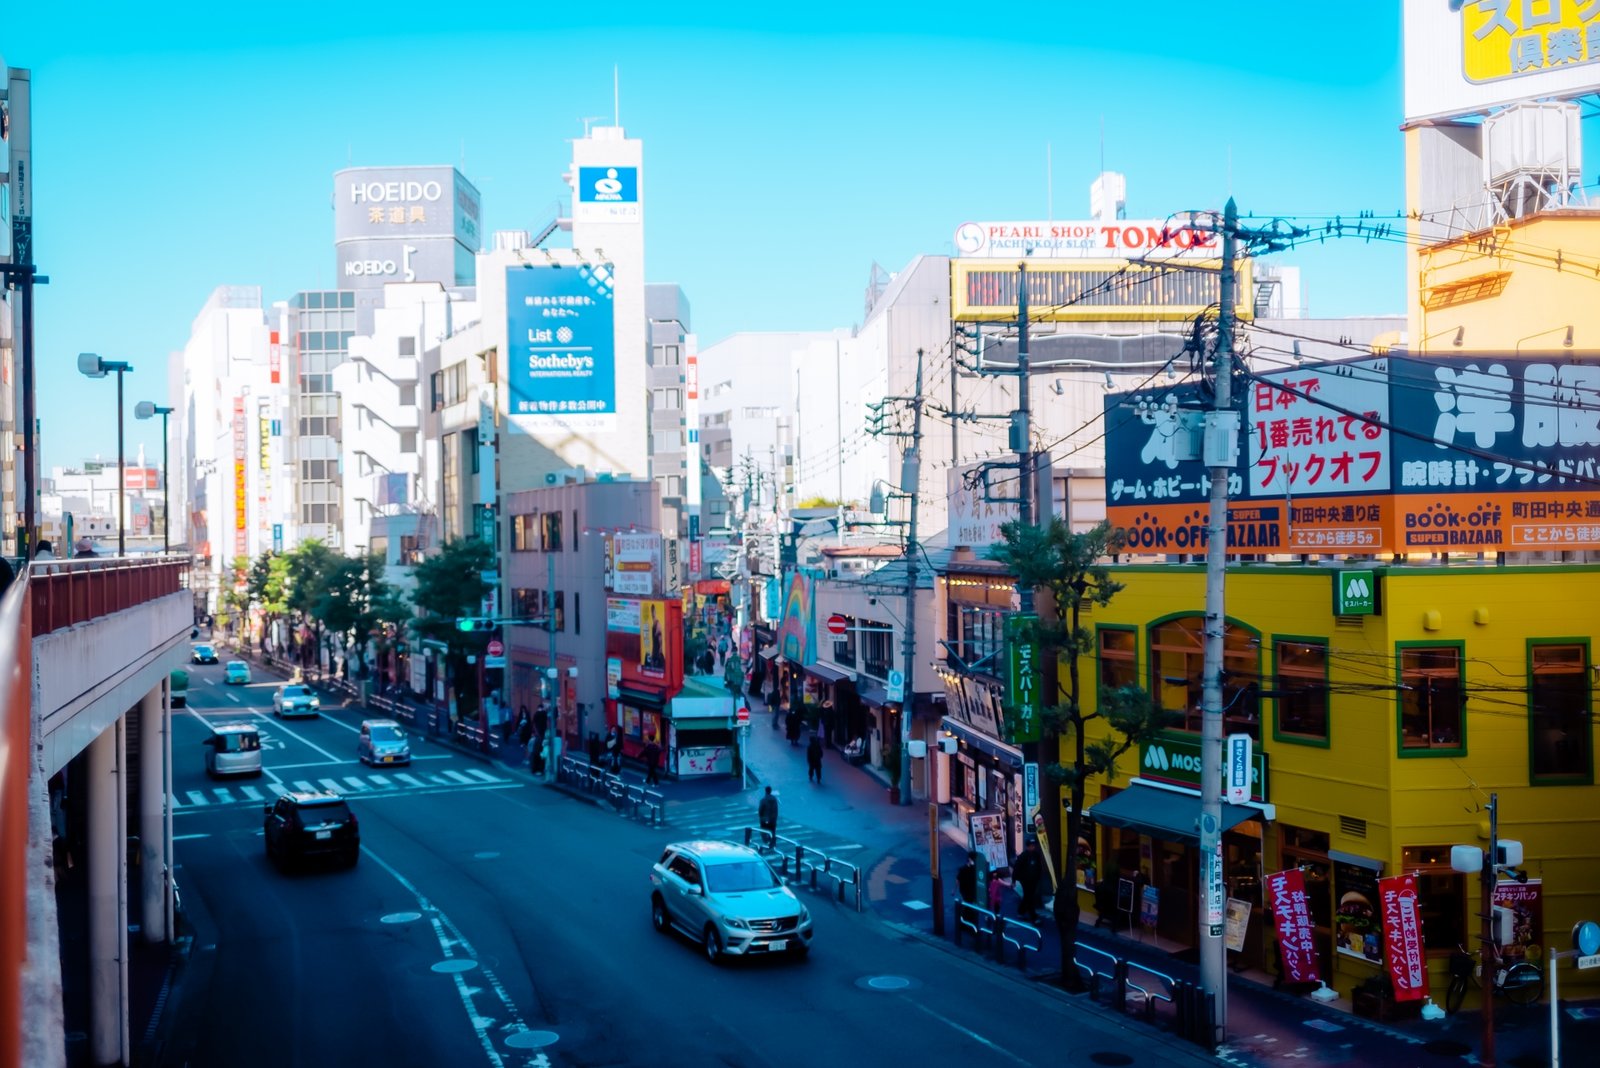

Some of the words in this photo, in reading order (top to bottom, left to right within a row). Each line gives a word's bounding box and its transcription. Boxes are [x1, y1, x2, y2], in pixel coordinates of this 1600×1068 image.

[351, 181, 441, 202] HOEIDO
[368, 206, 427, 225] 茶道具
[989, 226, 1044, 238] PEARL
[1051, 226, 1095, 238] SHOP
[989, 239, 1052, 249] PACHINKO
[1066, 239, 1096, 249] SLOT
[345, 260, 397, 276] HOEIDO
[528, 328, 552, 342] List
[529, 353, 594, 370] Sotheby's
[1255, 378, 1320, 413] 日本で
[1257, 410, 1382, 450] 1番売れてる
[1257, 451, 1382, 488] ブックオフ
[1402, 458, 1600, 487] 腕時計・ブランドバ
[1111, 472, 1243, 501] ゲーム・ホビー・トカ
[1233, 510, 1261, 520] SUPER
[1291, 505, 1380, 523] 町田中央通り店
[1227, 524, 1280, 547] AZAAR
[1297, 531, 1374, 545] ここから徒歩5分
[1410, 534, 1444, 543] SUPER
[1450, 530, 1503, 545] BAZAAR
[1172, 753, 1202, 773] MOS
